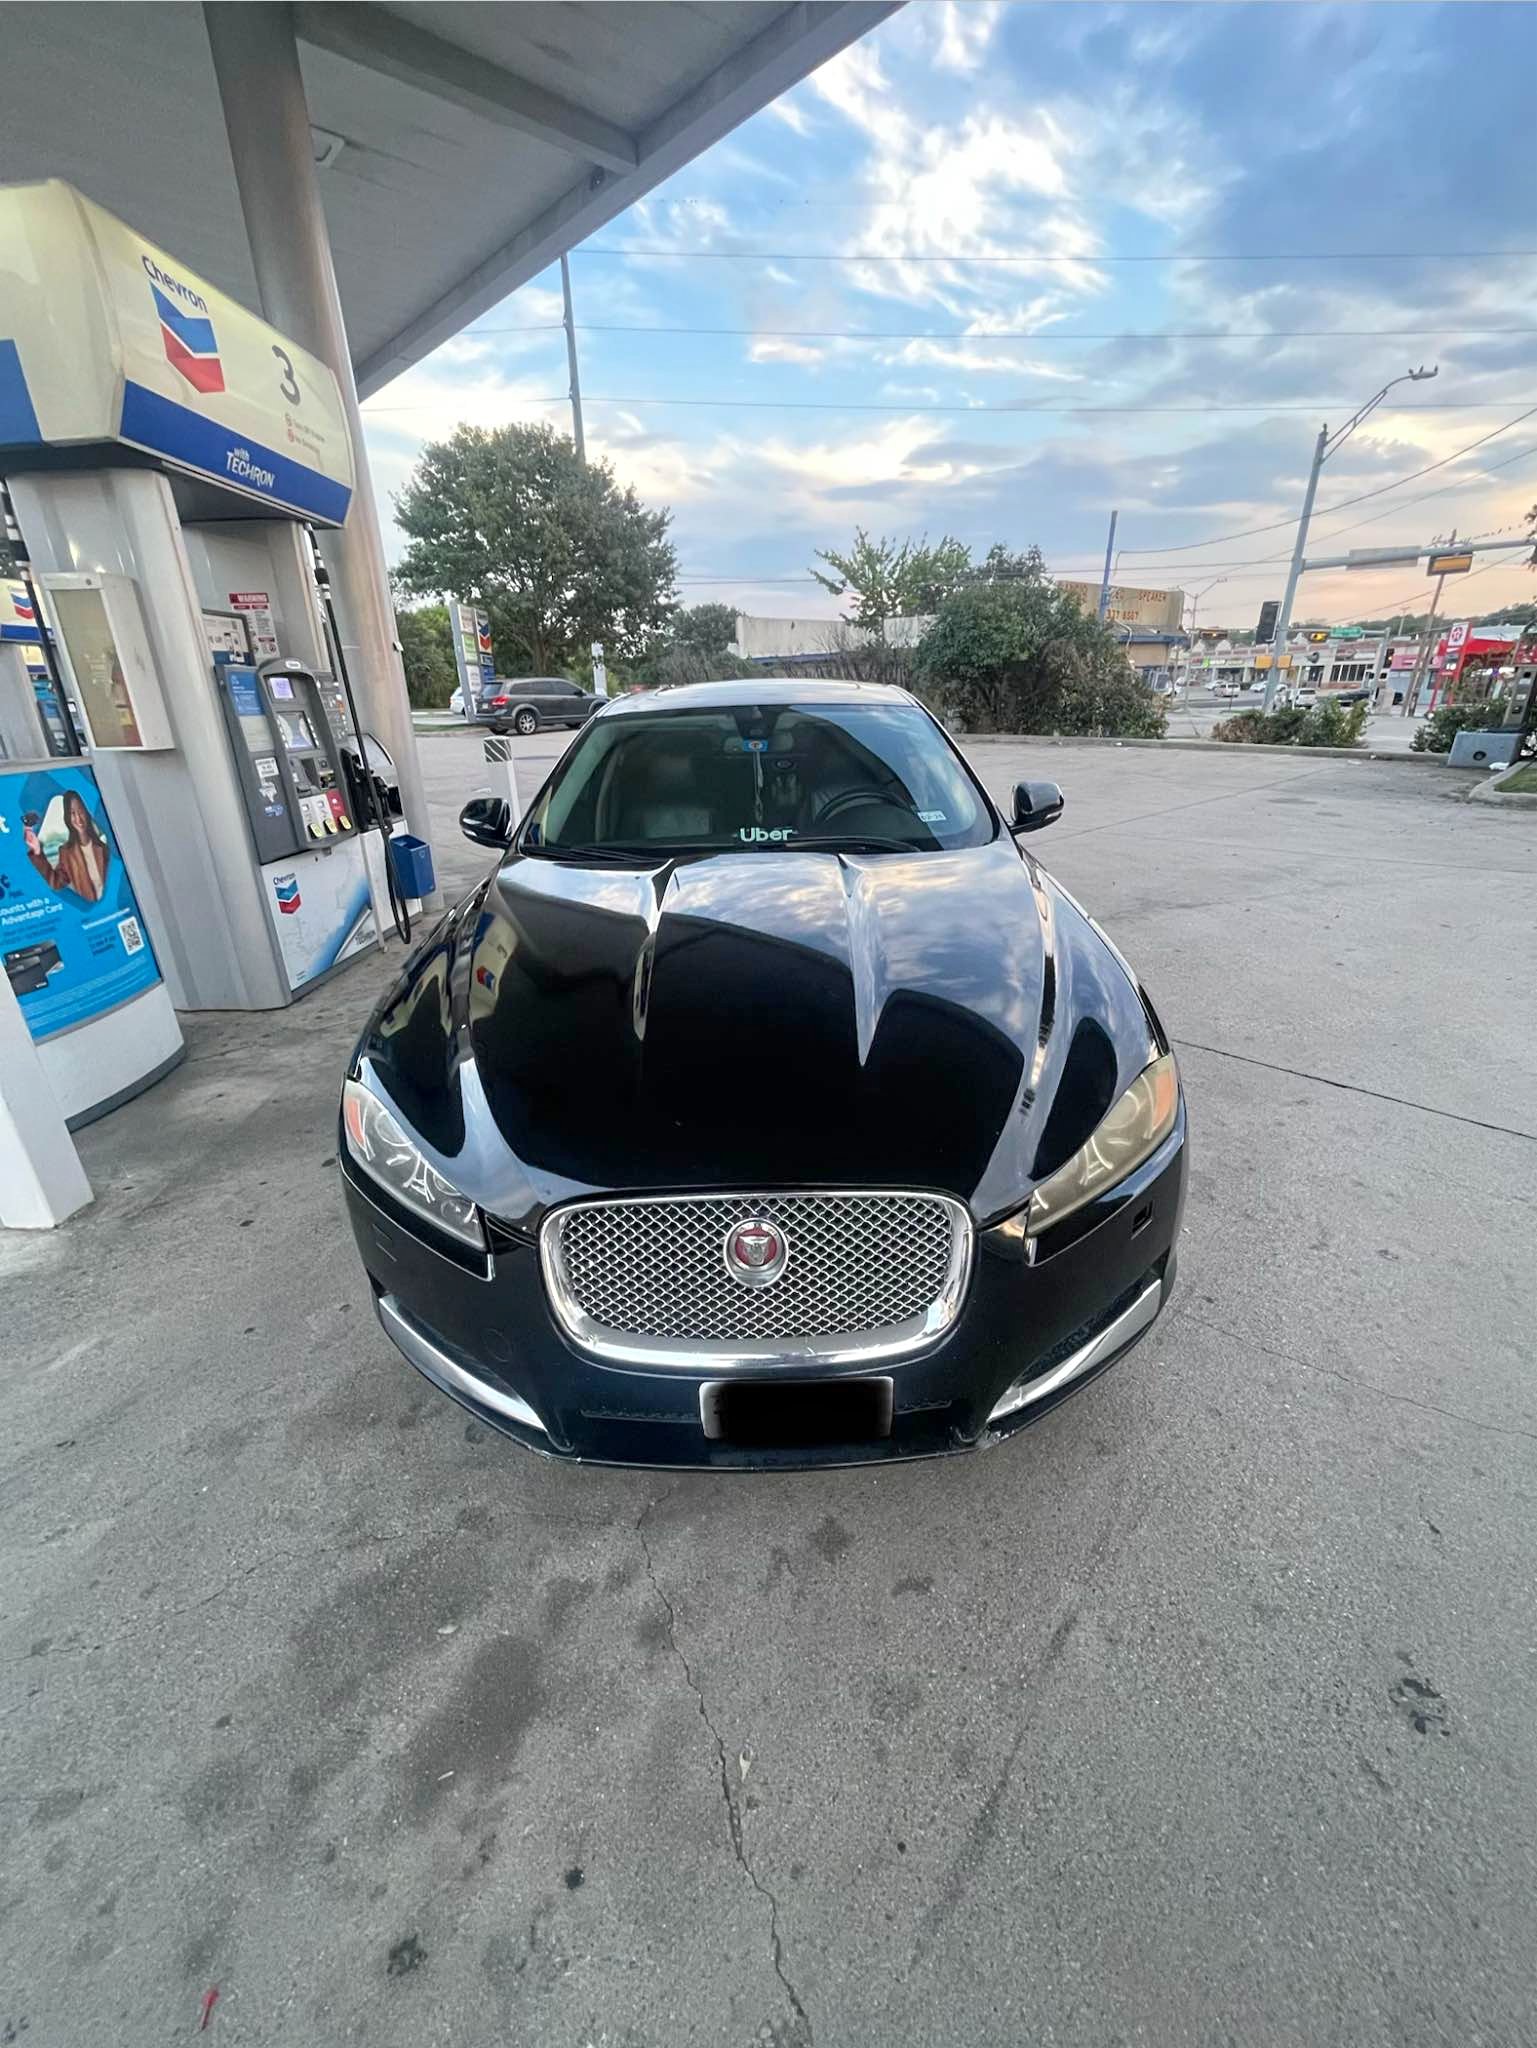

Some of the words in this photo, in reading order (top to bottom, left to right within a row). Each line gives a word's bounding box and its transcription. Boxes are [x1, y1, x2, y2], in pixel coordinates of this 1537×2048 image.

[142, 255, 208, 314] Chevron
[272, 345, 300, 406] 3
[234, 447, 250, 461] with
[226, 451, 275, 488] TECHRON
[740, 827, 793, 842] Uber
[273, 872, 296, 886] Chevron
